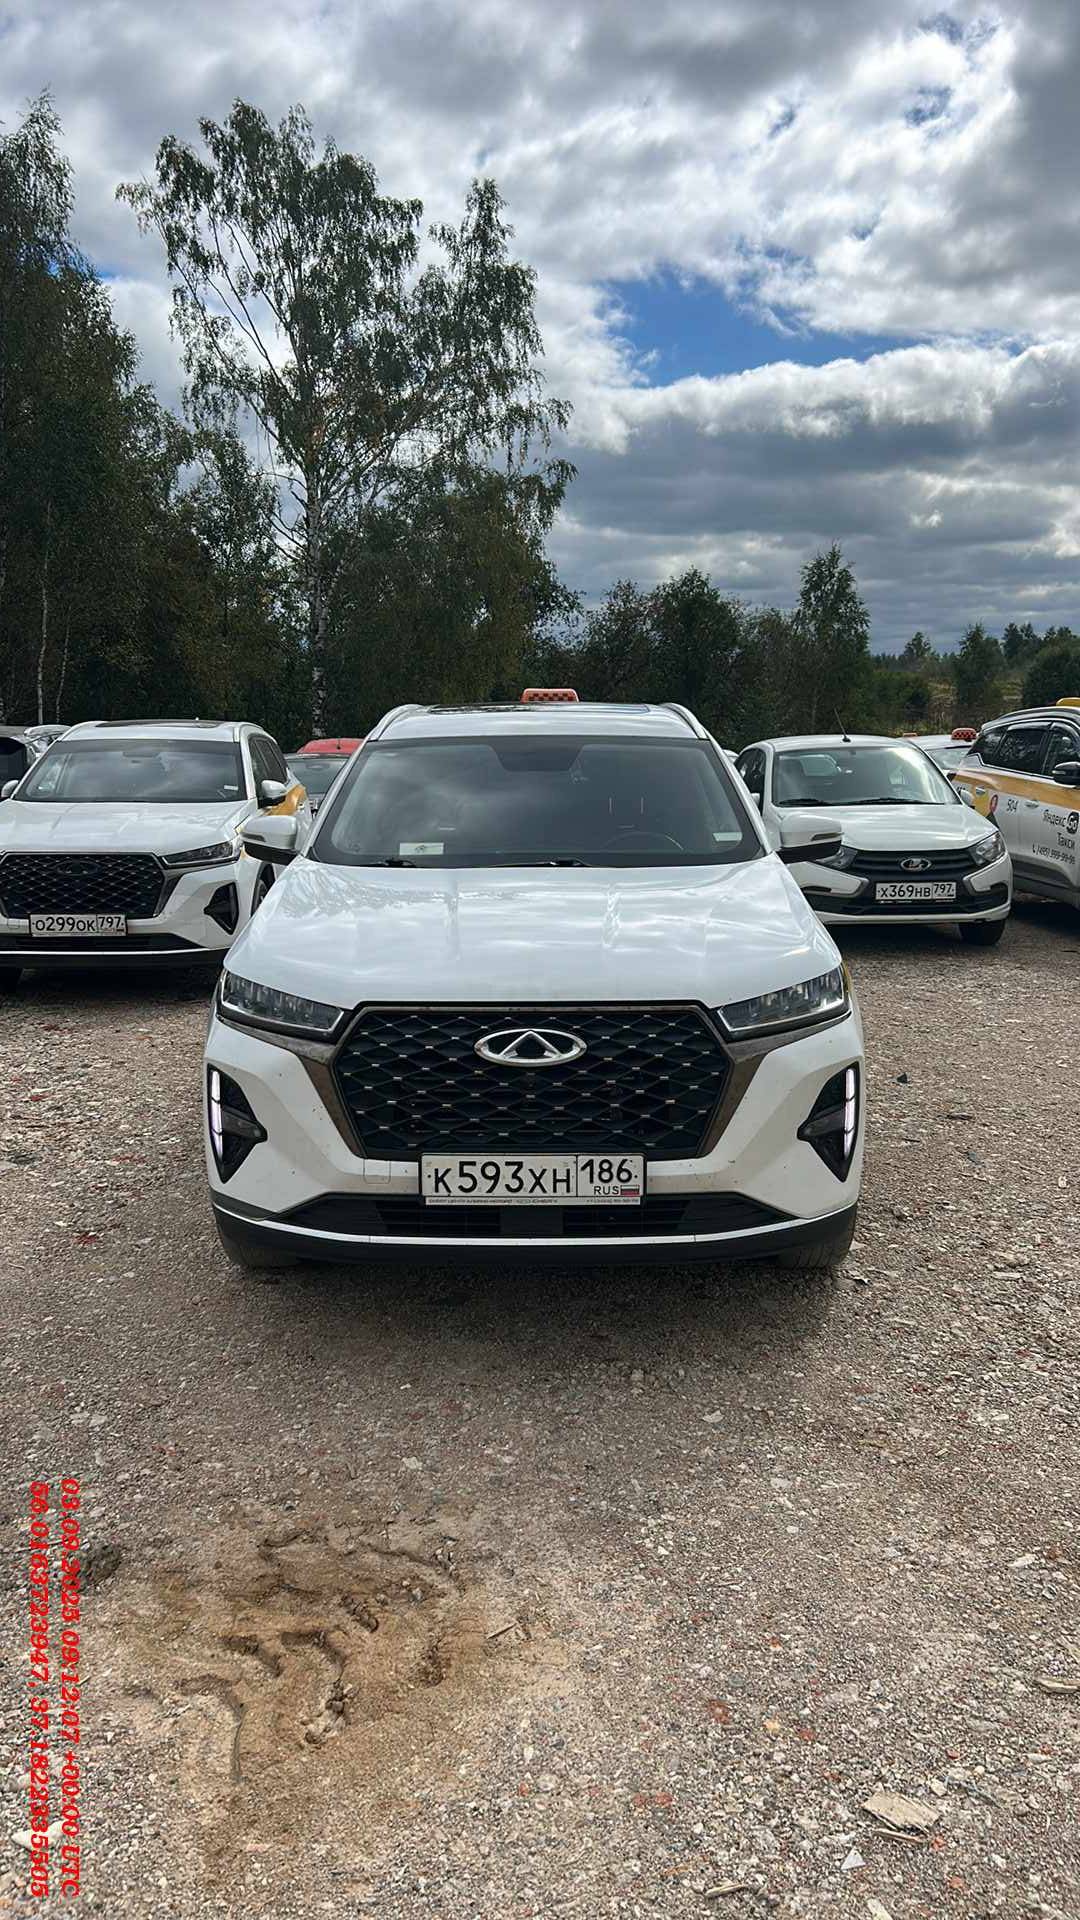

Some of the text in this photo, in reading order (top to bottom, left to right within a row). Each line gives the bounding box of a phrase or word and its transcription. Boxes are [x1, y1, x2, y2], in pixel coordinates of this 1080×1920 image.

[880, 883, 953, 898] Х369НВ 797
[35, 916, 121, 932] О299ОК 797
[433, 1158, 633, 1194] К593ХН 186
[593, 1185, 620, 1196] RUS
